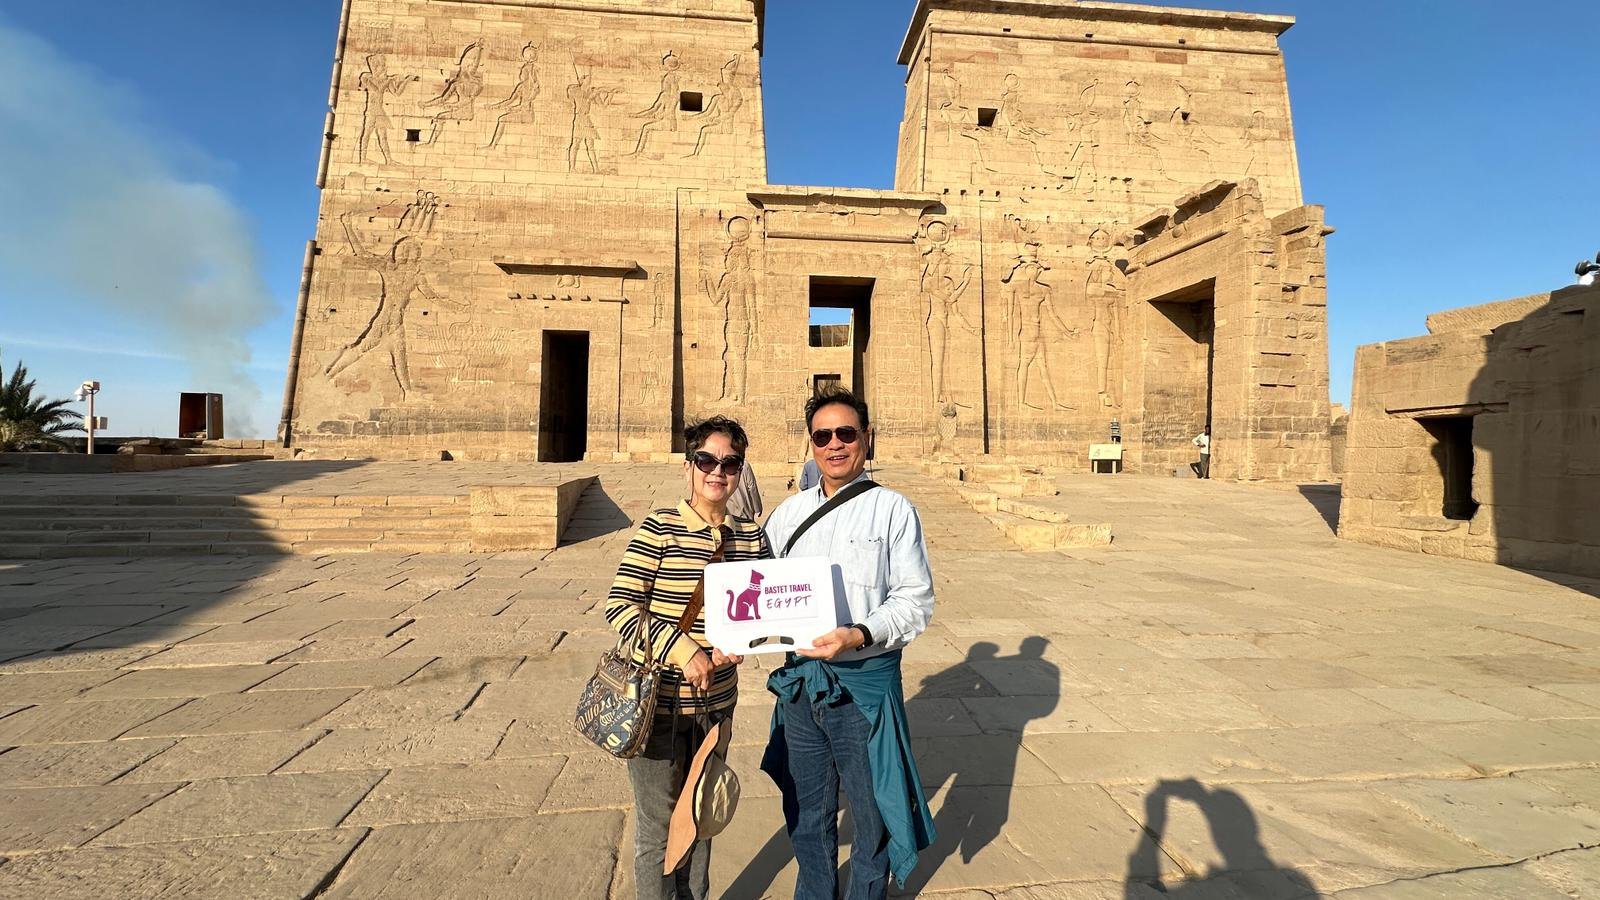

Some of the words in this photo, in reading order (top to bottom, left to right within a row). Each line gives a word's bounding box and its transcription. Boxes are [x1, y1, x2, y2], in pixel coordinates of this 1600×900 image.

[764, 586, 788, 594] BASTET
[790, 584, 812, 592] TRAVEL
[766, 595, 812, 609] EGYPT
